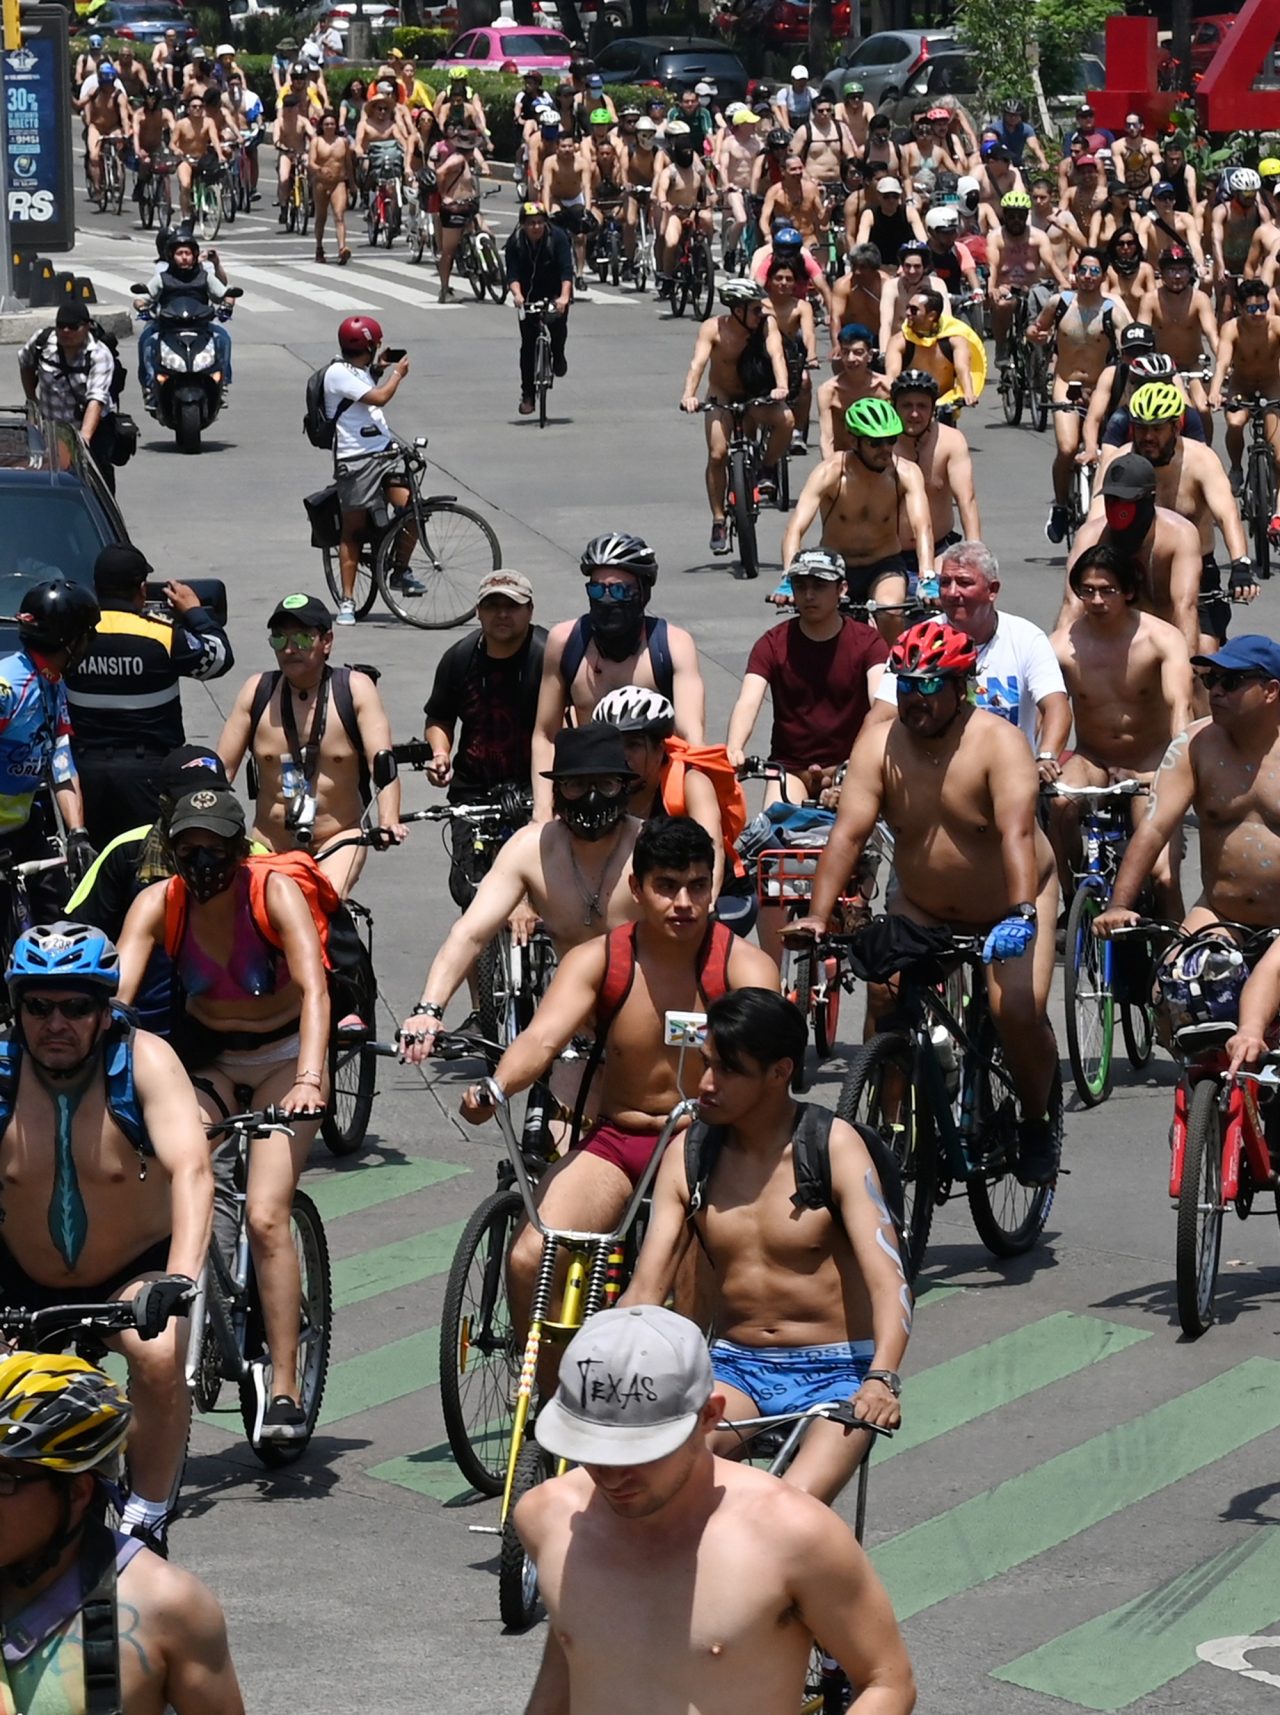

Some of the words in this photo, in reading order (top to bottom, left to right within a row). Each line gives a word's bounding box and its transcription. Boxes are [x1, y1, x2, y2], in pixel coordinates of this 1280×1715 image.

[7, 88, 38, 111] 30%
[1127, 328, 1144, 339] CN
[78, 656, 143, 675] RANSITO
